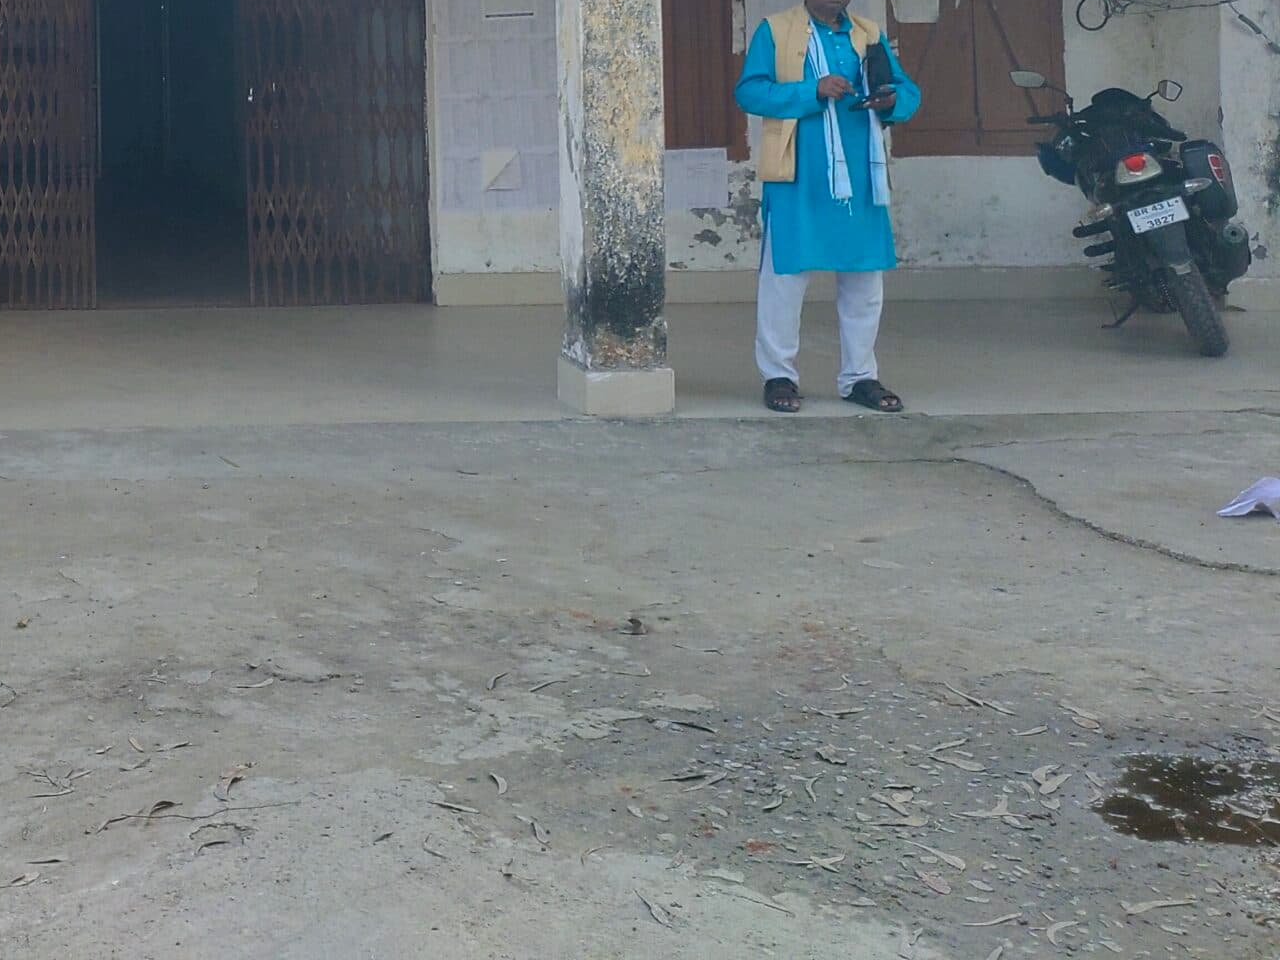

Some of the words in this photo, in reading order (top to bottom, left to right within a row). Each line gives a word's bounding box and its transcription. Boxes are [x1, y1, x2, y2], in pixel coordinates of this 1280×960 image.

[1133, 208, 1149, 217] BR
[1151, 203, 1165, 211] 43
[1147, 214, 1175, 227] 3827
